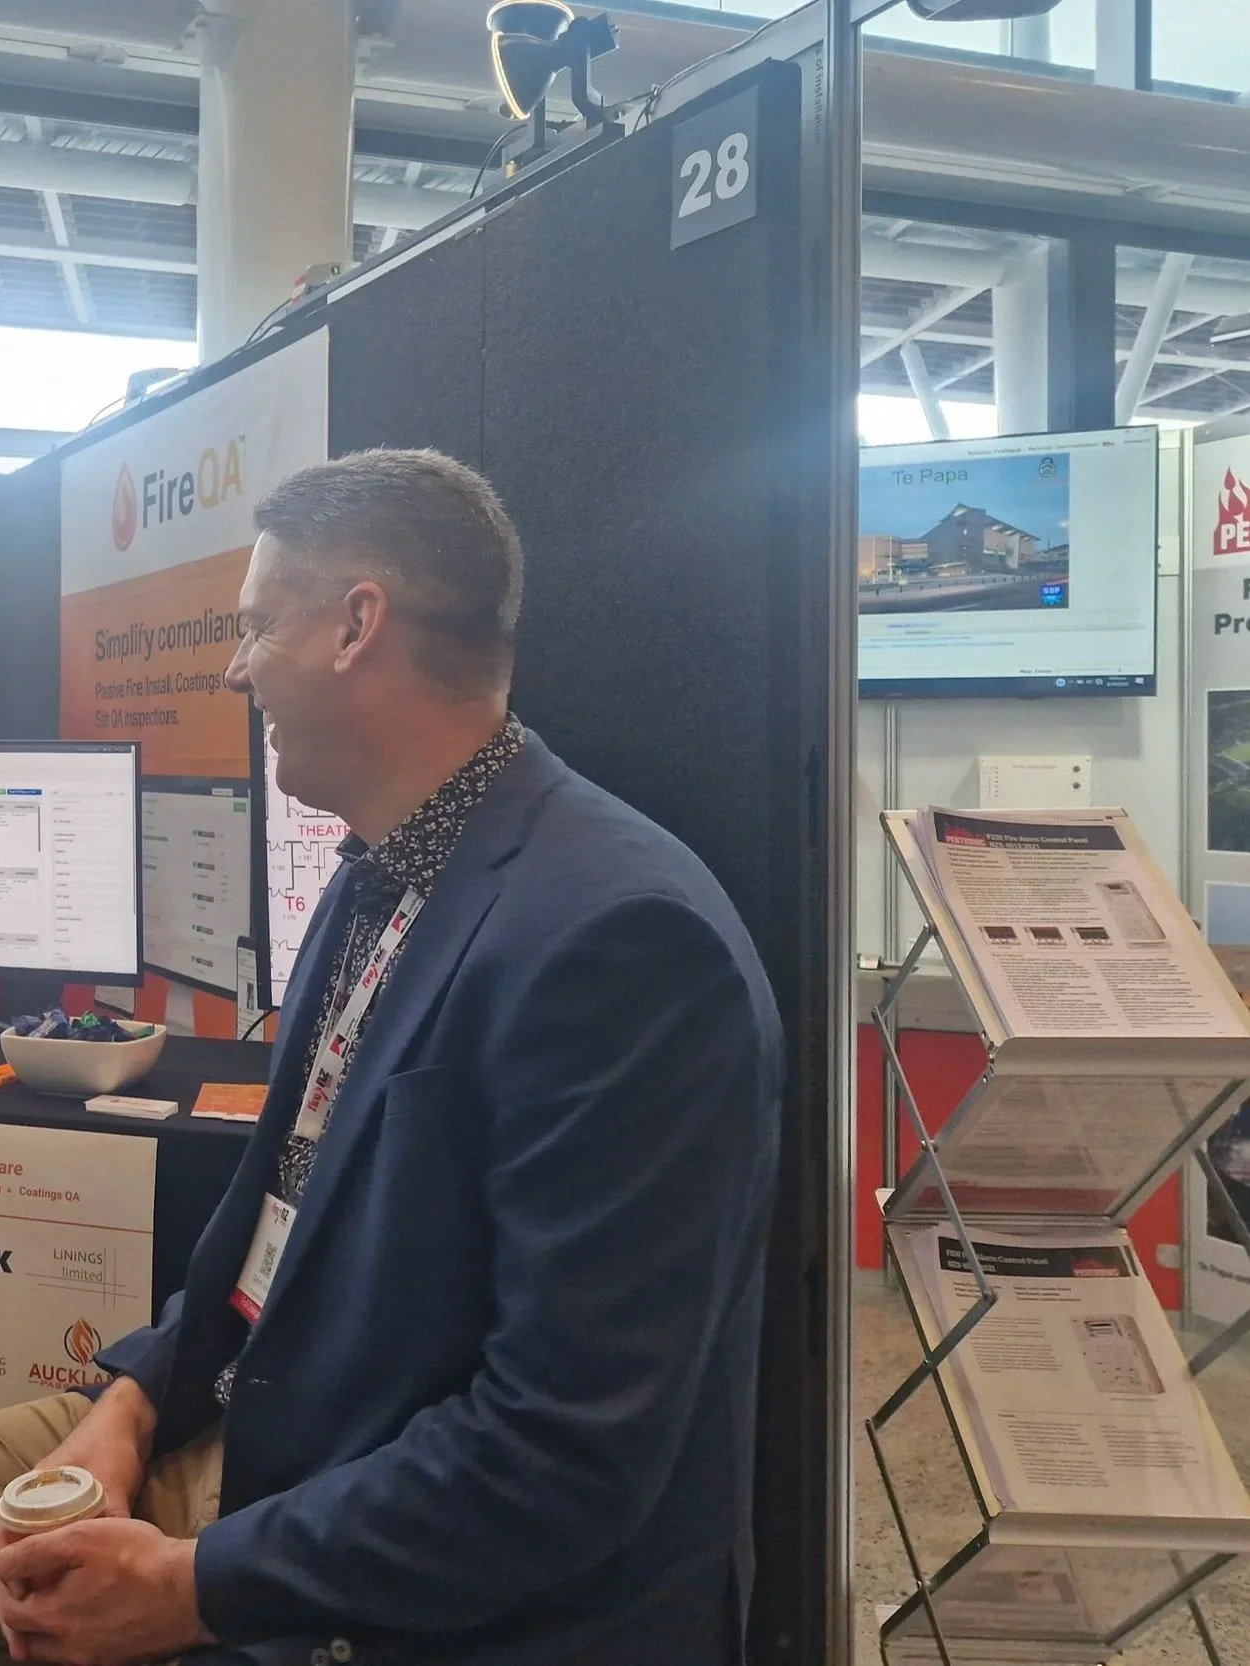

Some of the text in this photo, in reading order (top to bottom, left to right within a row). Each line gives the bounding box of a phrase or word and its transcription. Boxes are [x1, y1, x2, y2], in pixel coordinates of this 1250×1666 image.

[678, 132, 749, 219] 28
[143, 439, 242, 529] FireQA
[892, 468, 968, 486] Te Papa
[95, 608, 248, 665] Simplify complianc
[176, 669, 220, 694] Coatings
[285, 896, 305, 911] T6
[19, 1186, 62, 1202] Coatings
[64, 1190, 80, 1202] QA
[62, 1266, 103, 1282] limited
